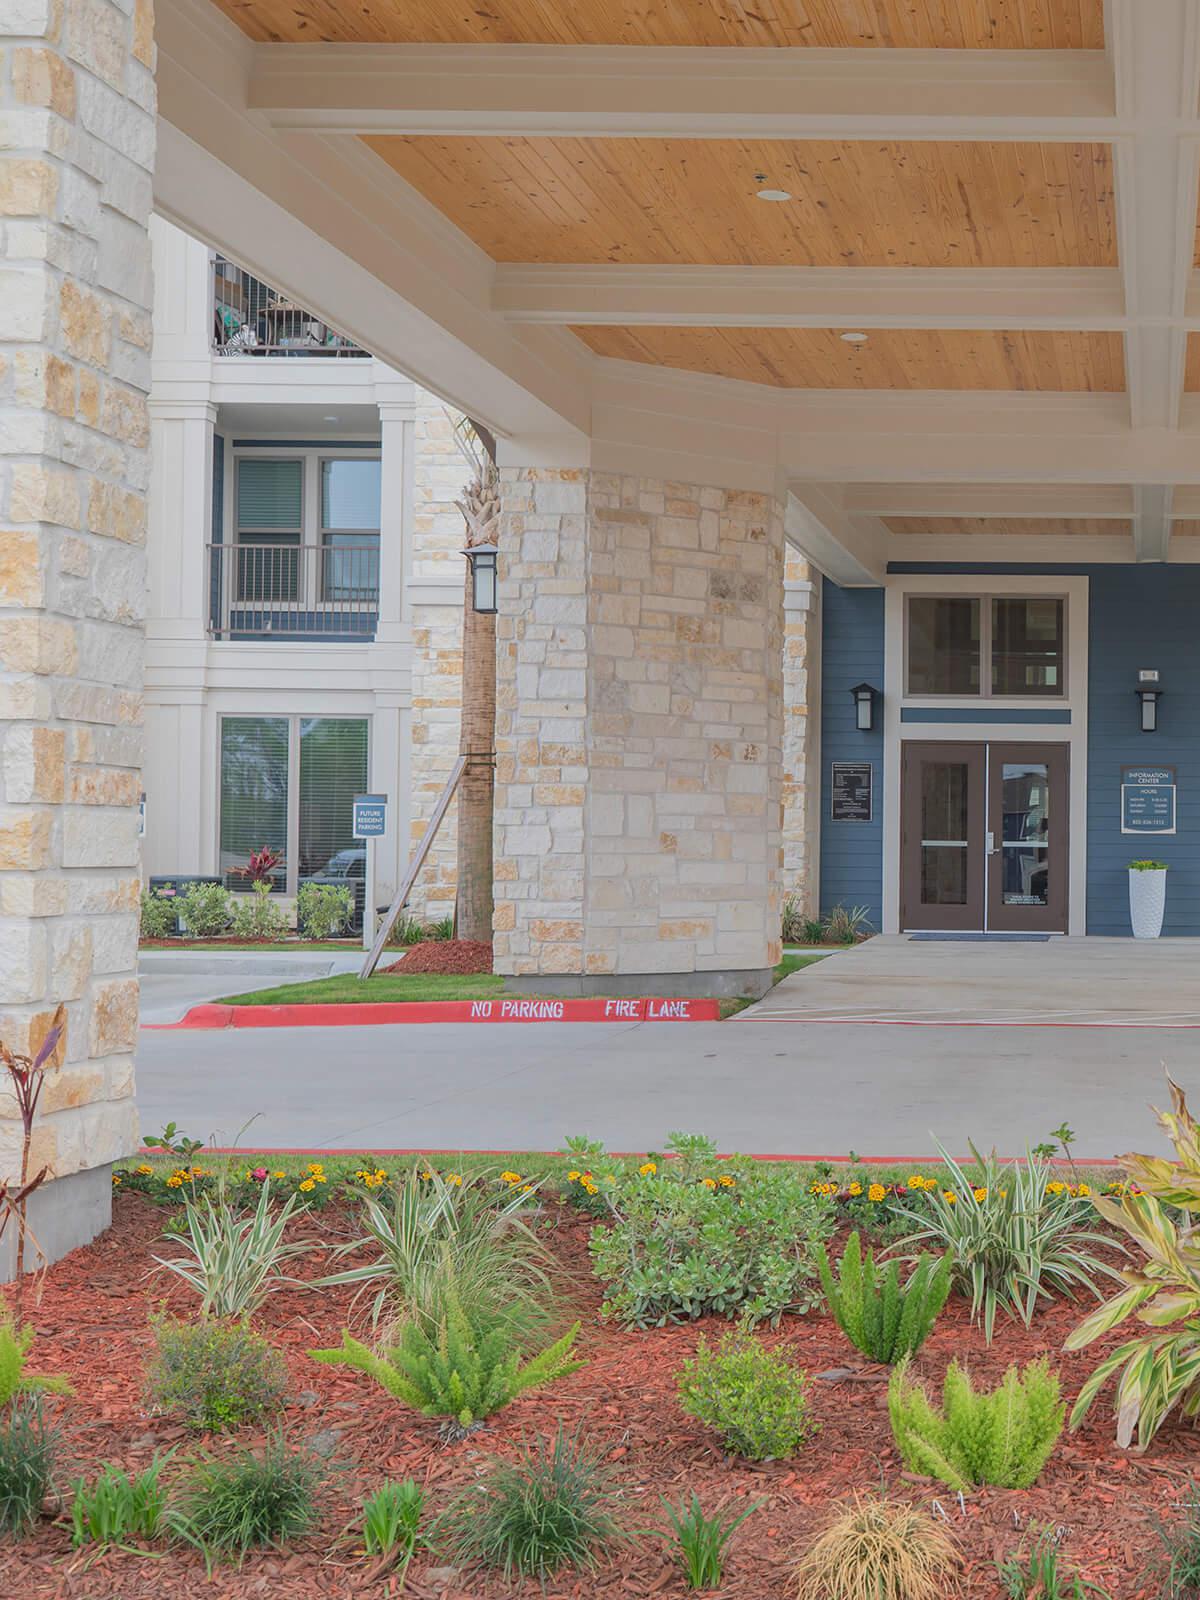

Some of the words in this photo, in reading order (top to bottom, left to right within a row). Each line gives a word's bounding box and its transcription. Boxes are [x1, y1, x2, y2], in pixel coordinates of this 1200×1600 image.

[471, 1001, 492, 1017] NO
[501, 1001, 564, 1018] PARKING
[605, 1000, 640, 1017] FIRE
[649, 1001, 690, 1018] LANE
